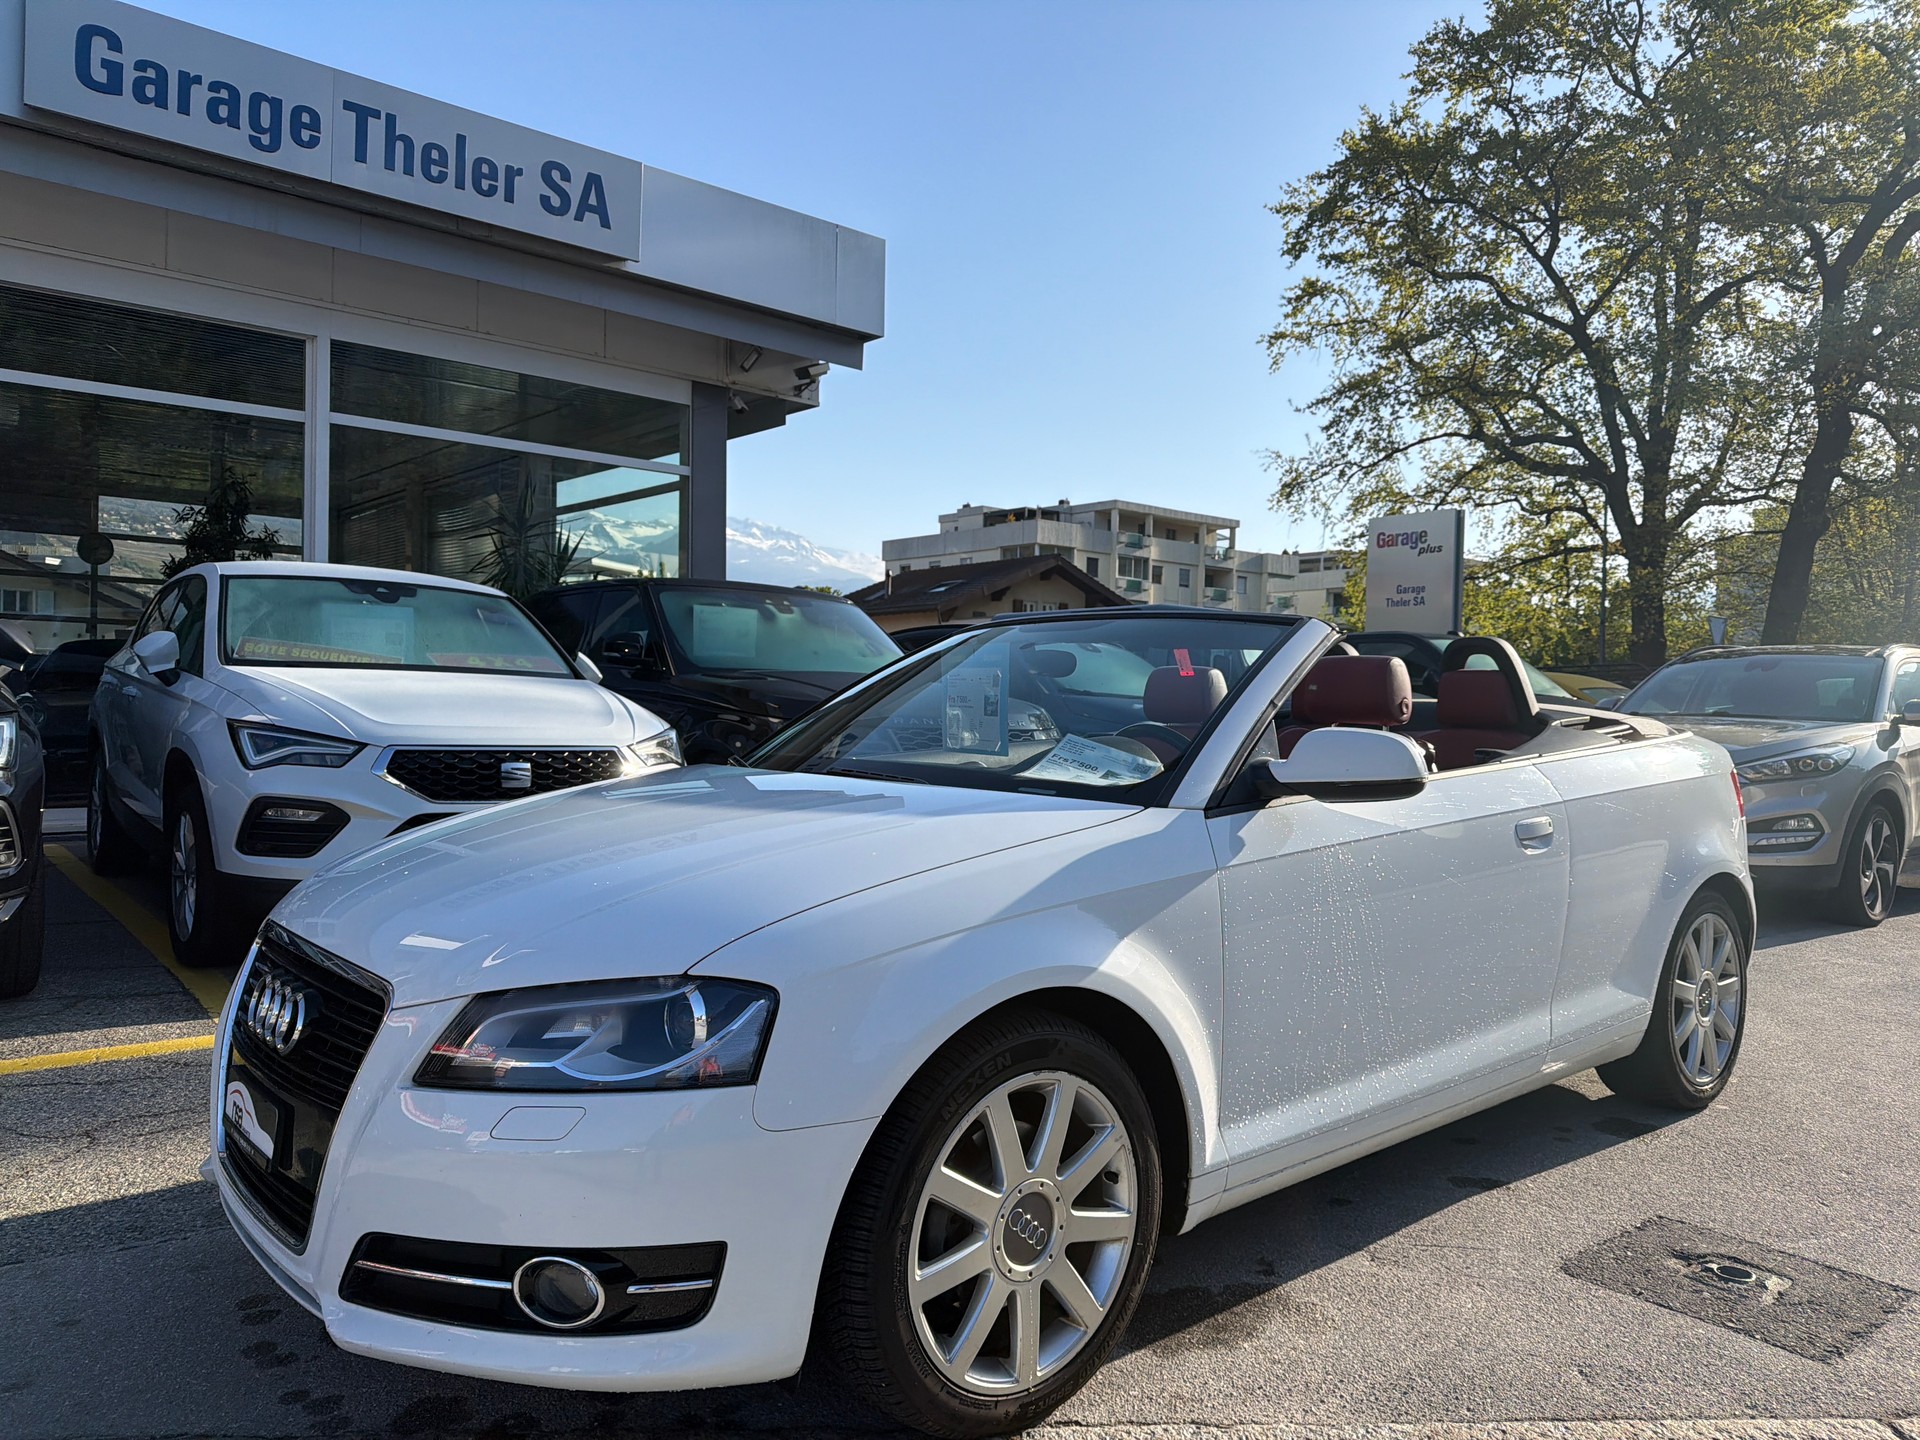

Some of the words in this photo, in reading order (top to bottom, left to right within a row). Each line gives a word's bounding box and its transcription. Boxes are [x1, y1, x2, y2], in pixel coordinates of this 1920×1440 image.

[74, 23, 321, 153] Garage
[342, 99, 523, 204] Theler
[538, 160, 612, 230] SA
[1376, 530, 1428, 550] Garage
[1417, 543, 1443, 557] plus
[1396, 584, 1426, 595] Garage
[1385, 598, 1411, 608] Theler
[1413, 596, 1426, 606] SA
[1051, 753, 1070, 763] Frs
[941, 1052, 1012, 1121] NEXEN
